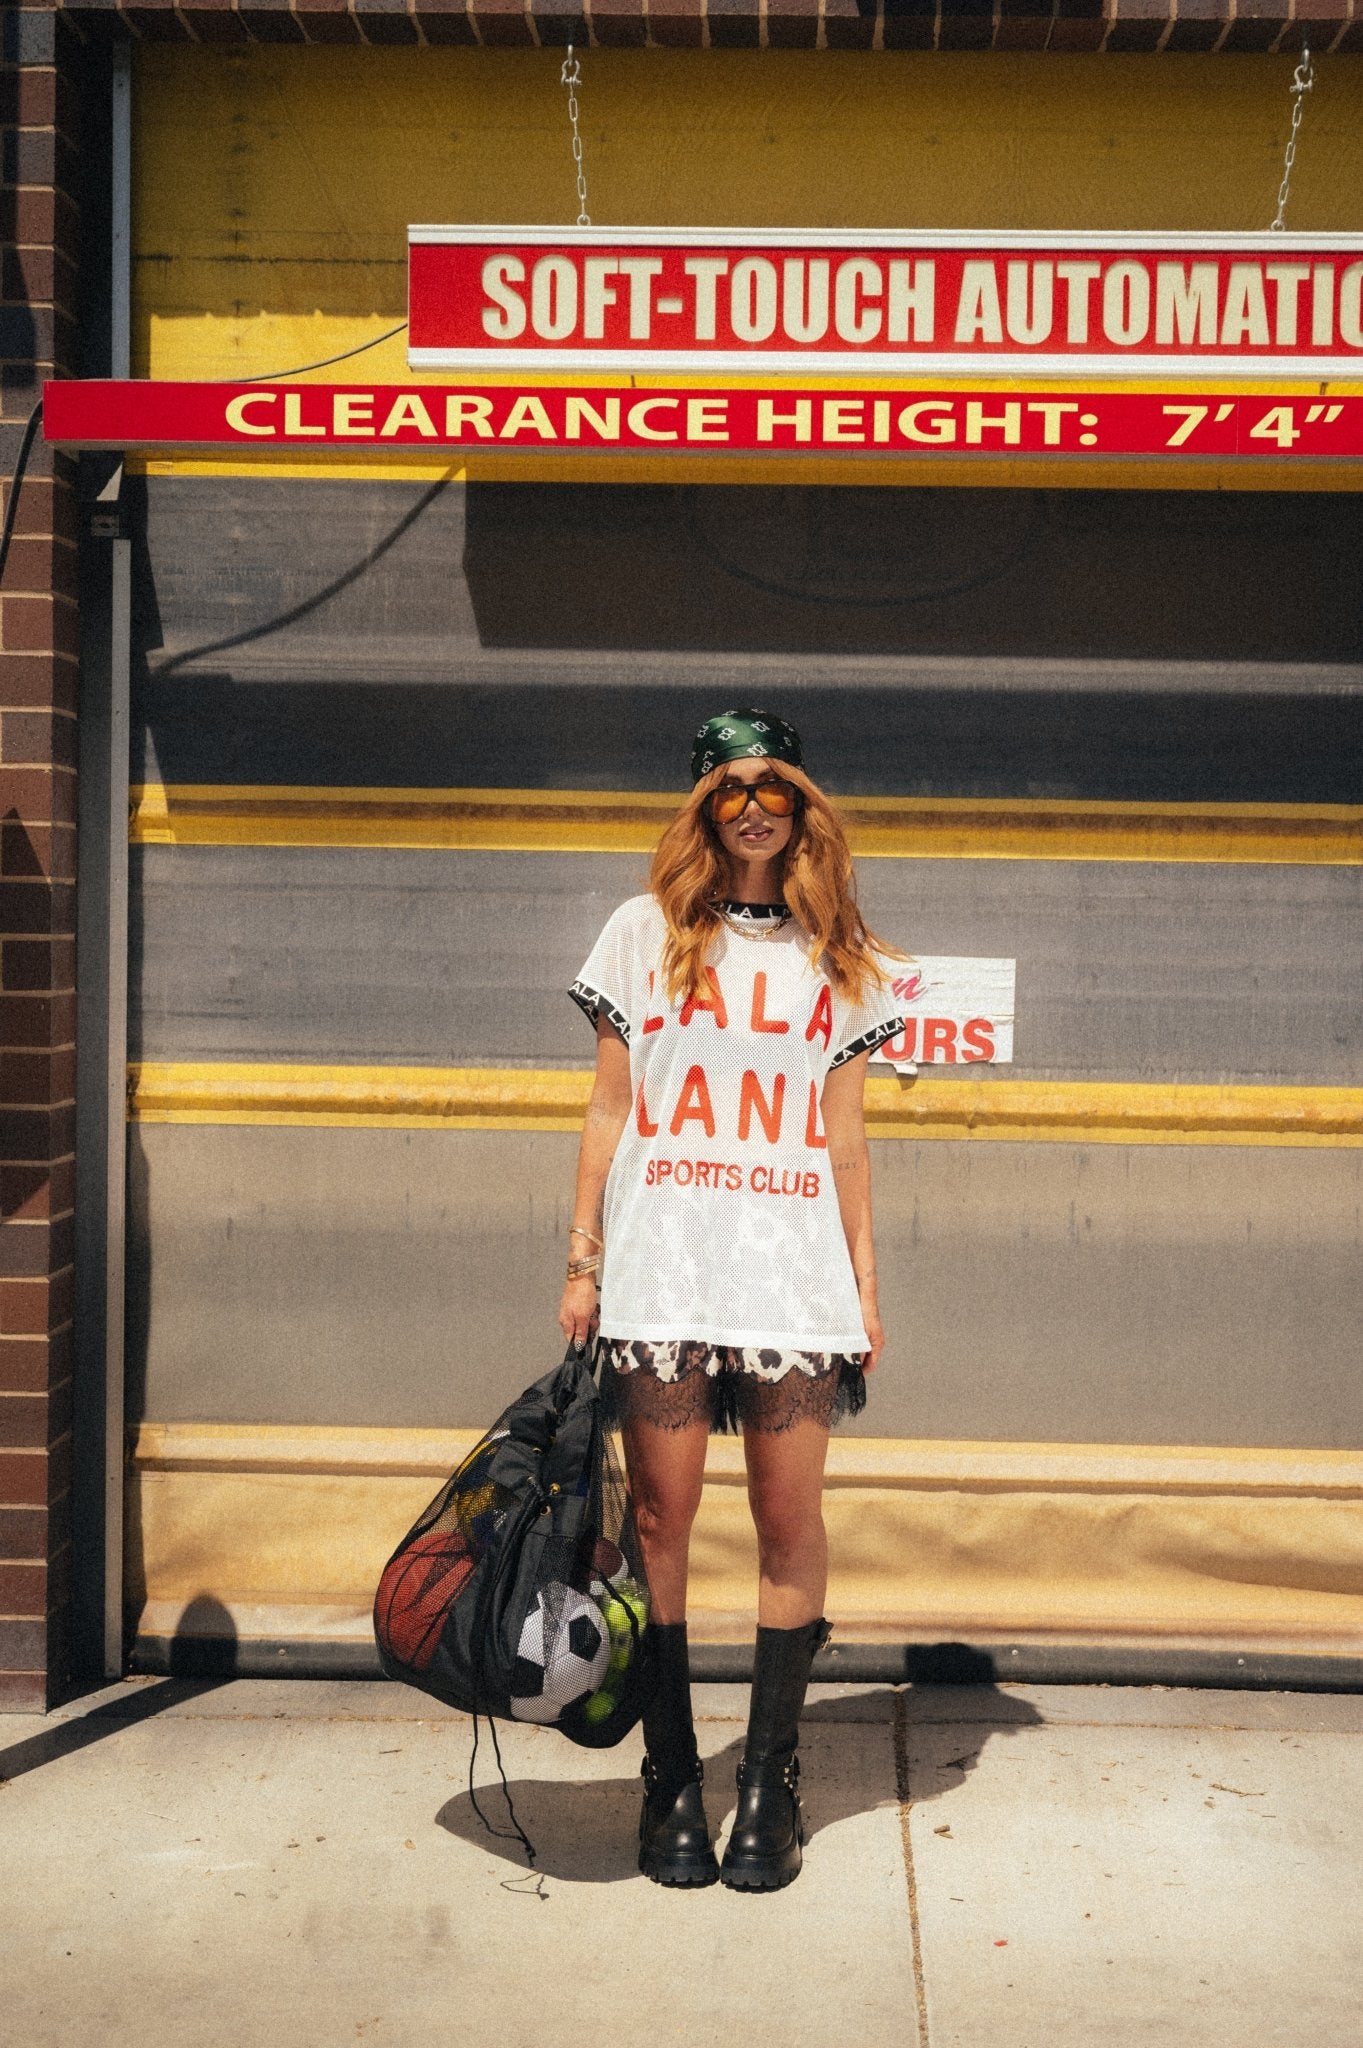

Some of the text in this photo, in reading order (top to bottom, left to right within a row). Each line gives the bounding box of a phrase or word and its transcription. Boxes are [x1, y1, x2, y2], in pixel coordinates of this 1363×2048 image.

[481, 253, 936, 344] SOFT-TOUCH
[224, 391, 730, 442] CLEARANCE
[755, 399, 1100, 446] HEIGHT:
[861, 1018, 905, 1046] LALA
[645, 1159, 822, 1199] SPORTS CLUB
